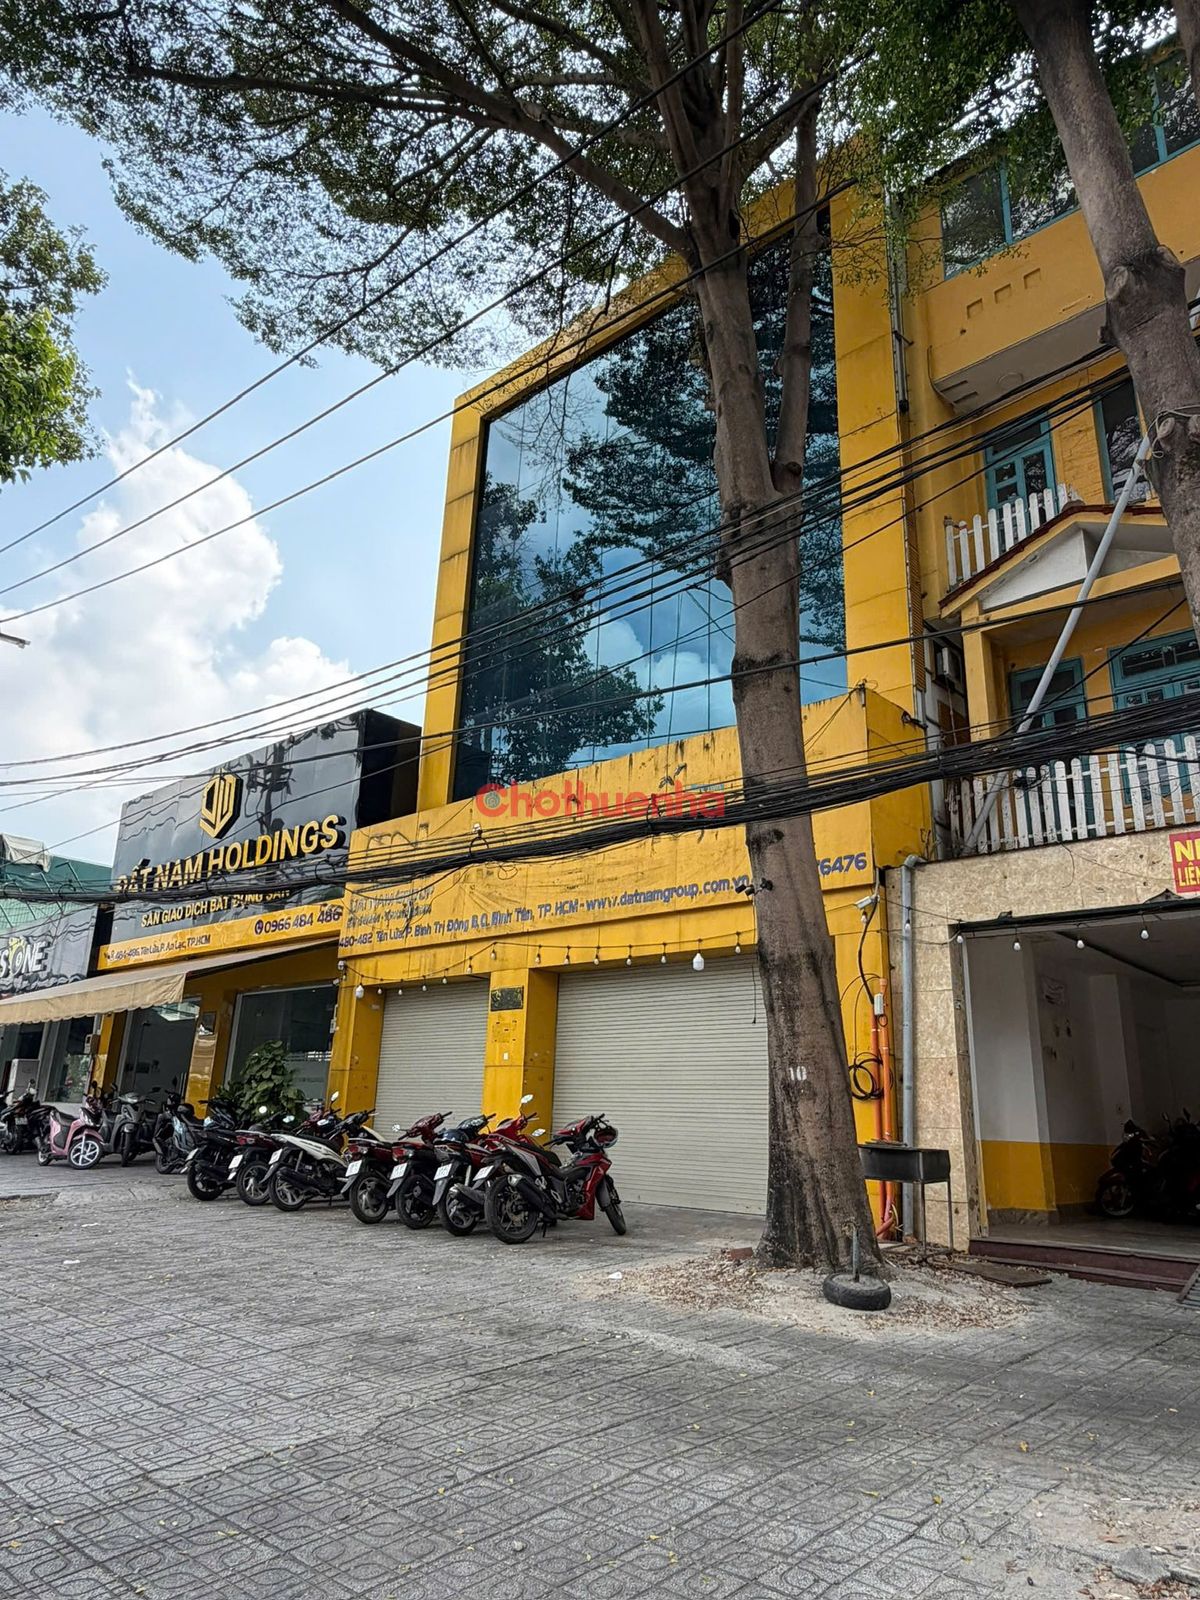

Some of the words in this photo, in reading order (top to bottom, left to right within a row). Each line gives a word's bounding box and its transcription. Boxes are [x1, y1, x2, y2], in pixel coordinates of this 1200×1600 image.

[153, 852, 204, 891] NAM
[207, 814, 340, 879] HOLDINGS
[161, 906, 183, 924] GIAO
[264, 917, 291, 934] 0966
[292, 912, 314, 929] 484
[316, 905, 343, 924] 486
